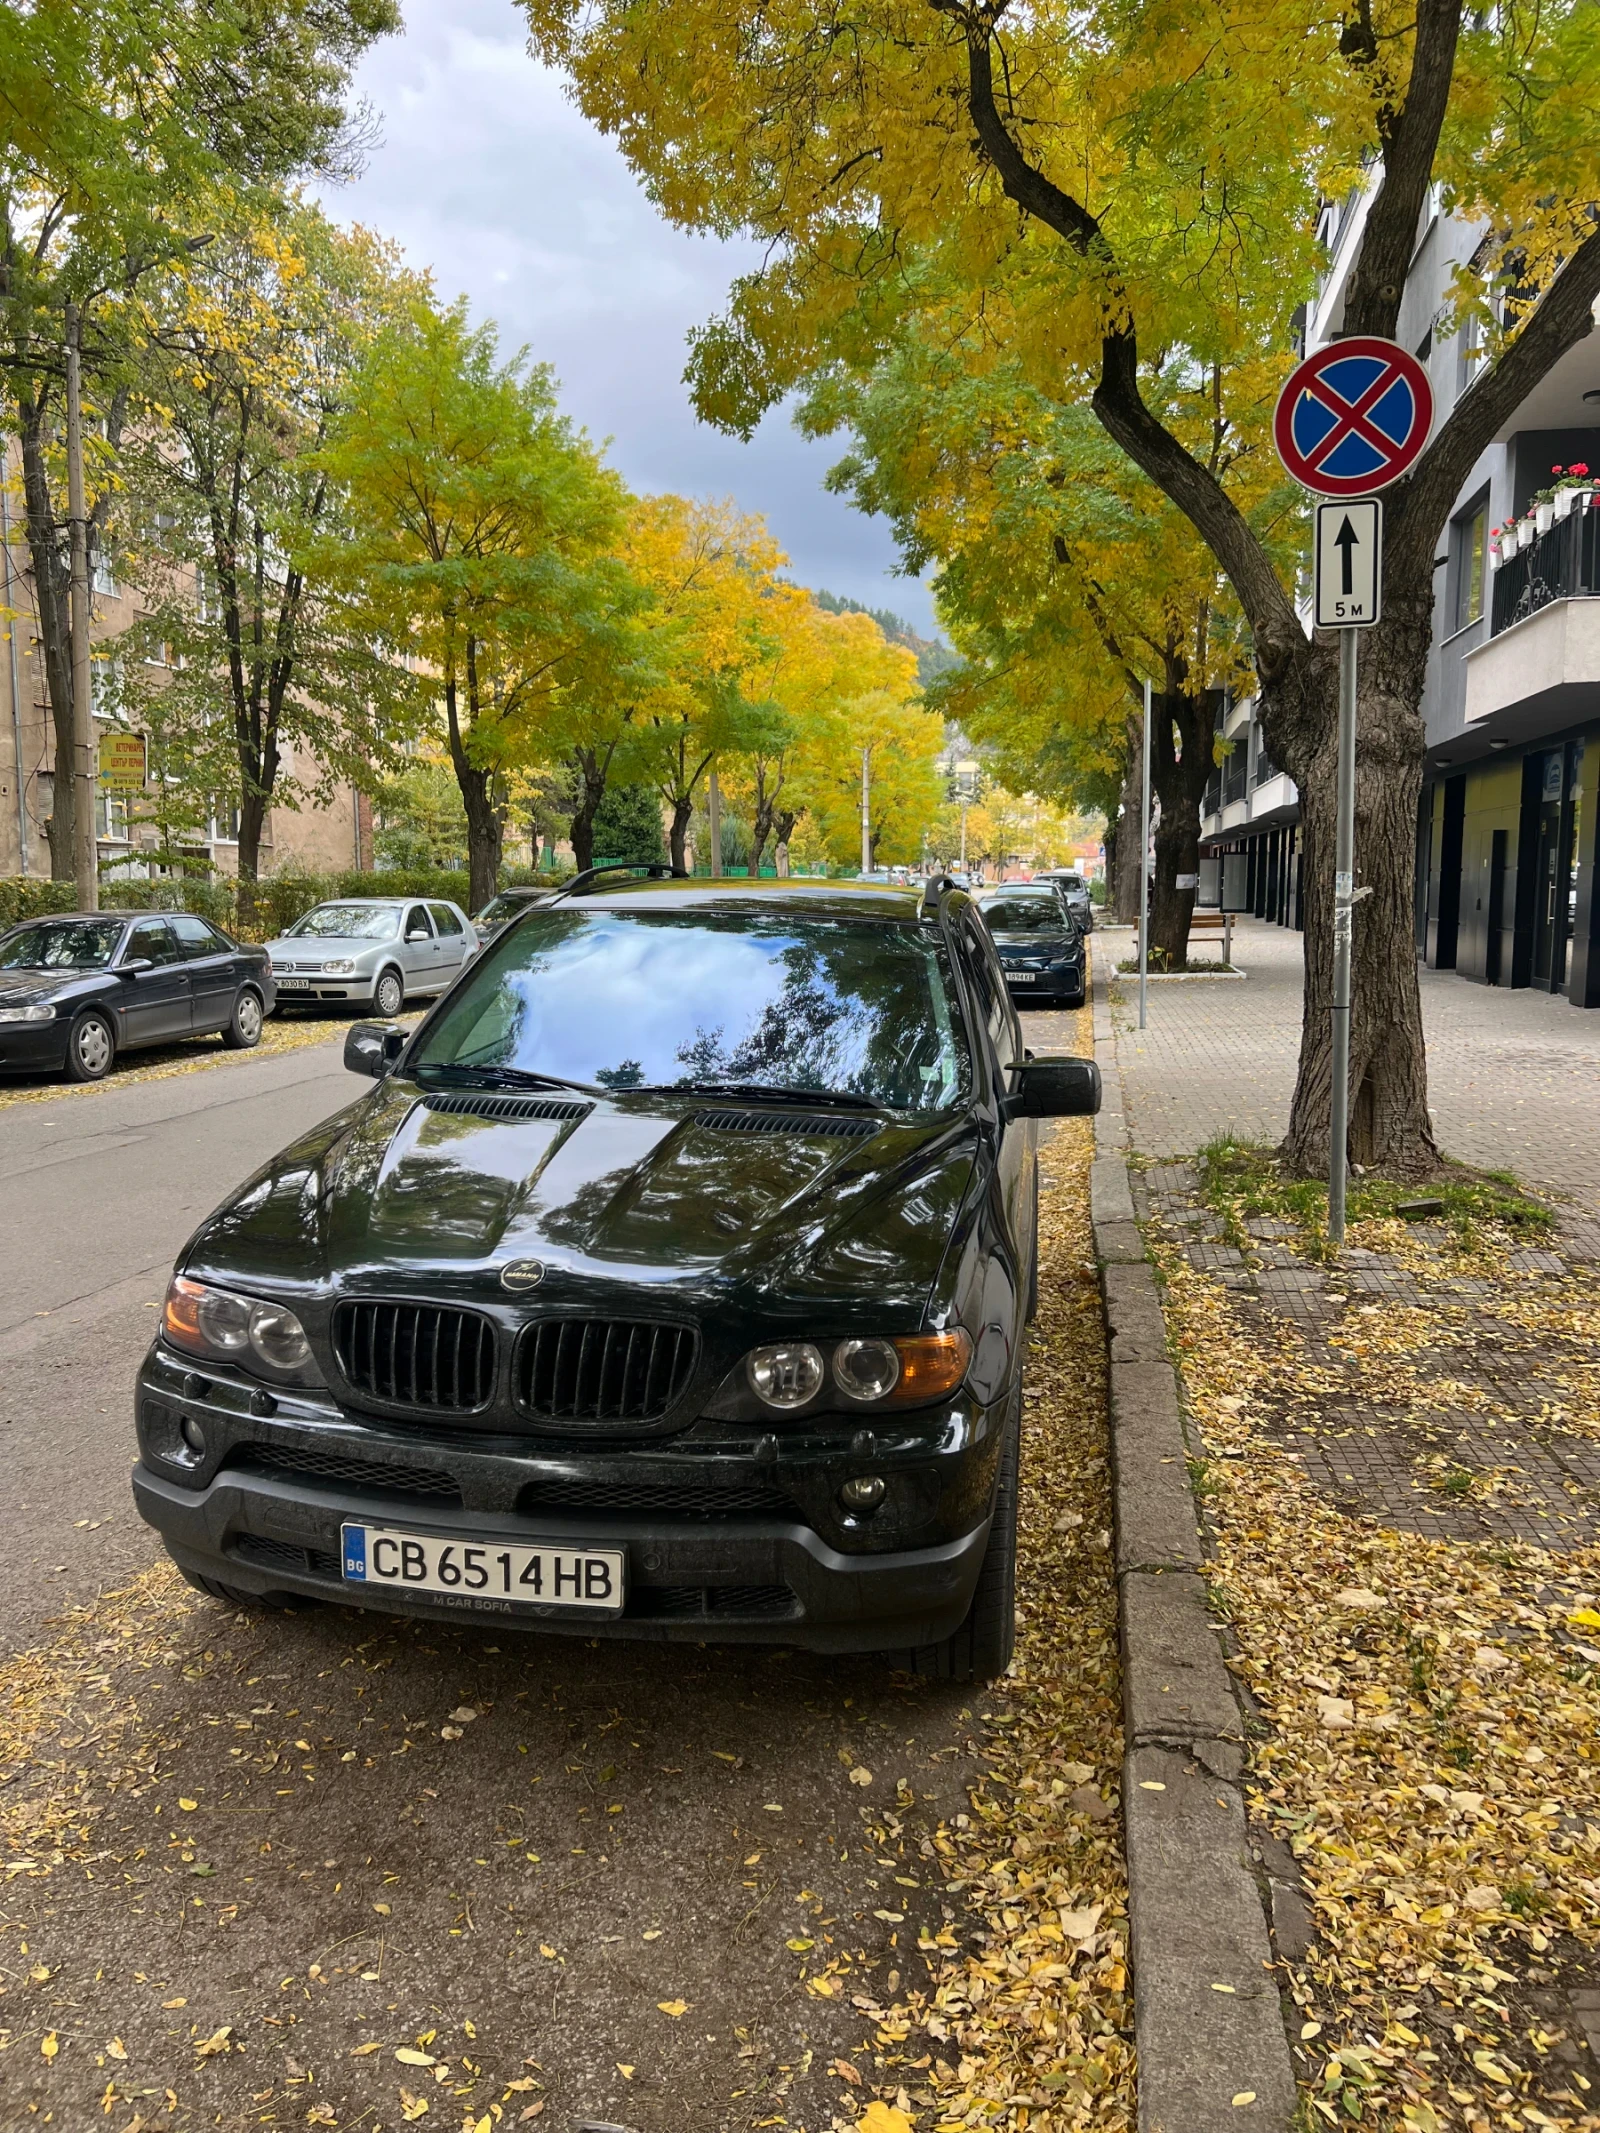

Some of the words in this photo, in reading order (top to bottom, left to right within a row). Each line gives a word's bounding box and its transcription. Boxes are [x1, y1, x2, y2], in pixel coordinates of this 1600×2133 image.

[1335, 601, 1346, 618] 5
[111, 757, 127, 768] ЦЕНТЪР
[281, 980, 297, 988] 8030
[346, 1559, 364, 1572] BG
[373, 1538, 427, 1581] CB
[438, 1546, 543, 1595] 6514
[554, 1557, 612, 1599] HB
[433, 1595, 444, 1605] M
[446, 1596, 472, 1609] CAR
[474, 1600, 512, 1613] SOFIA
